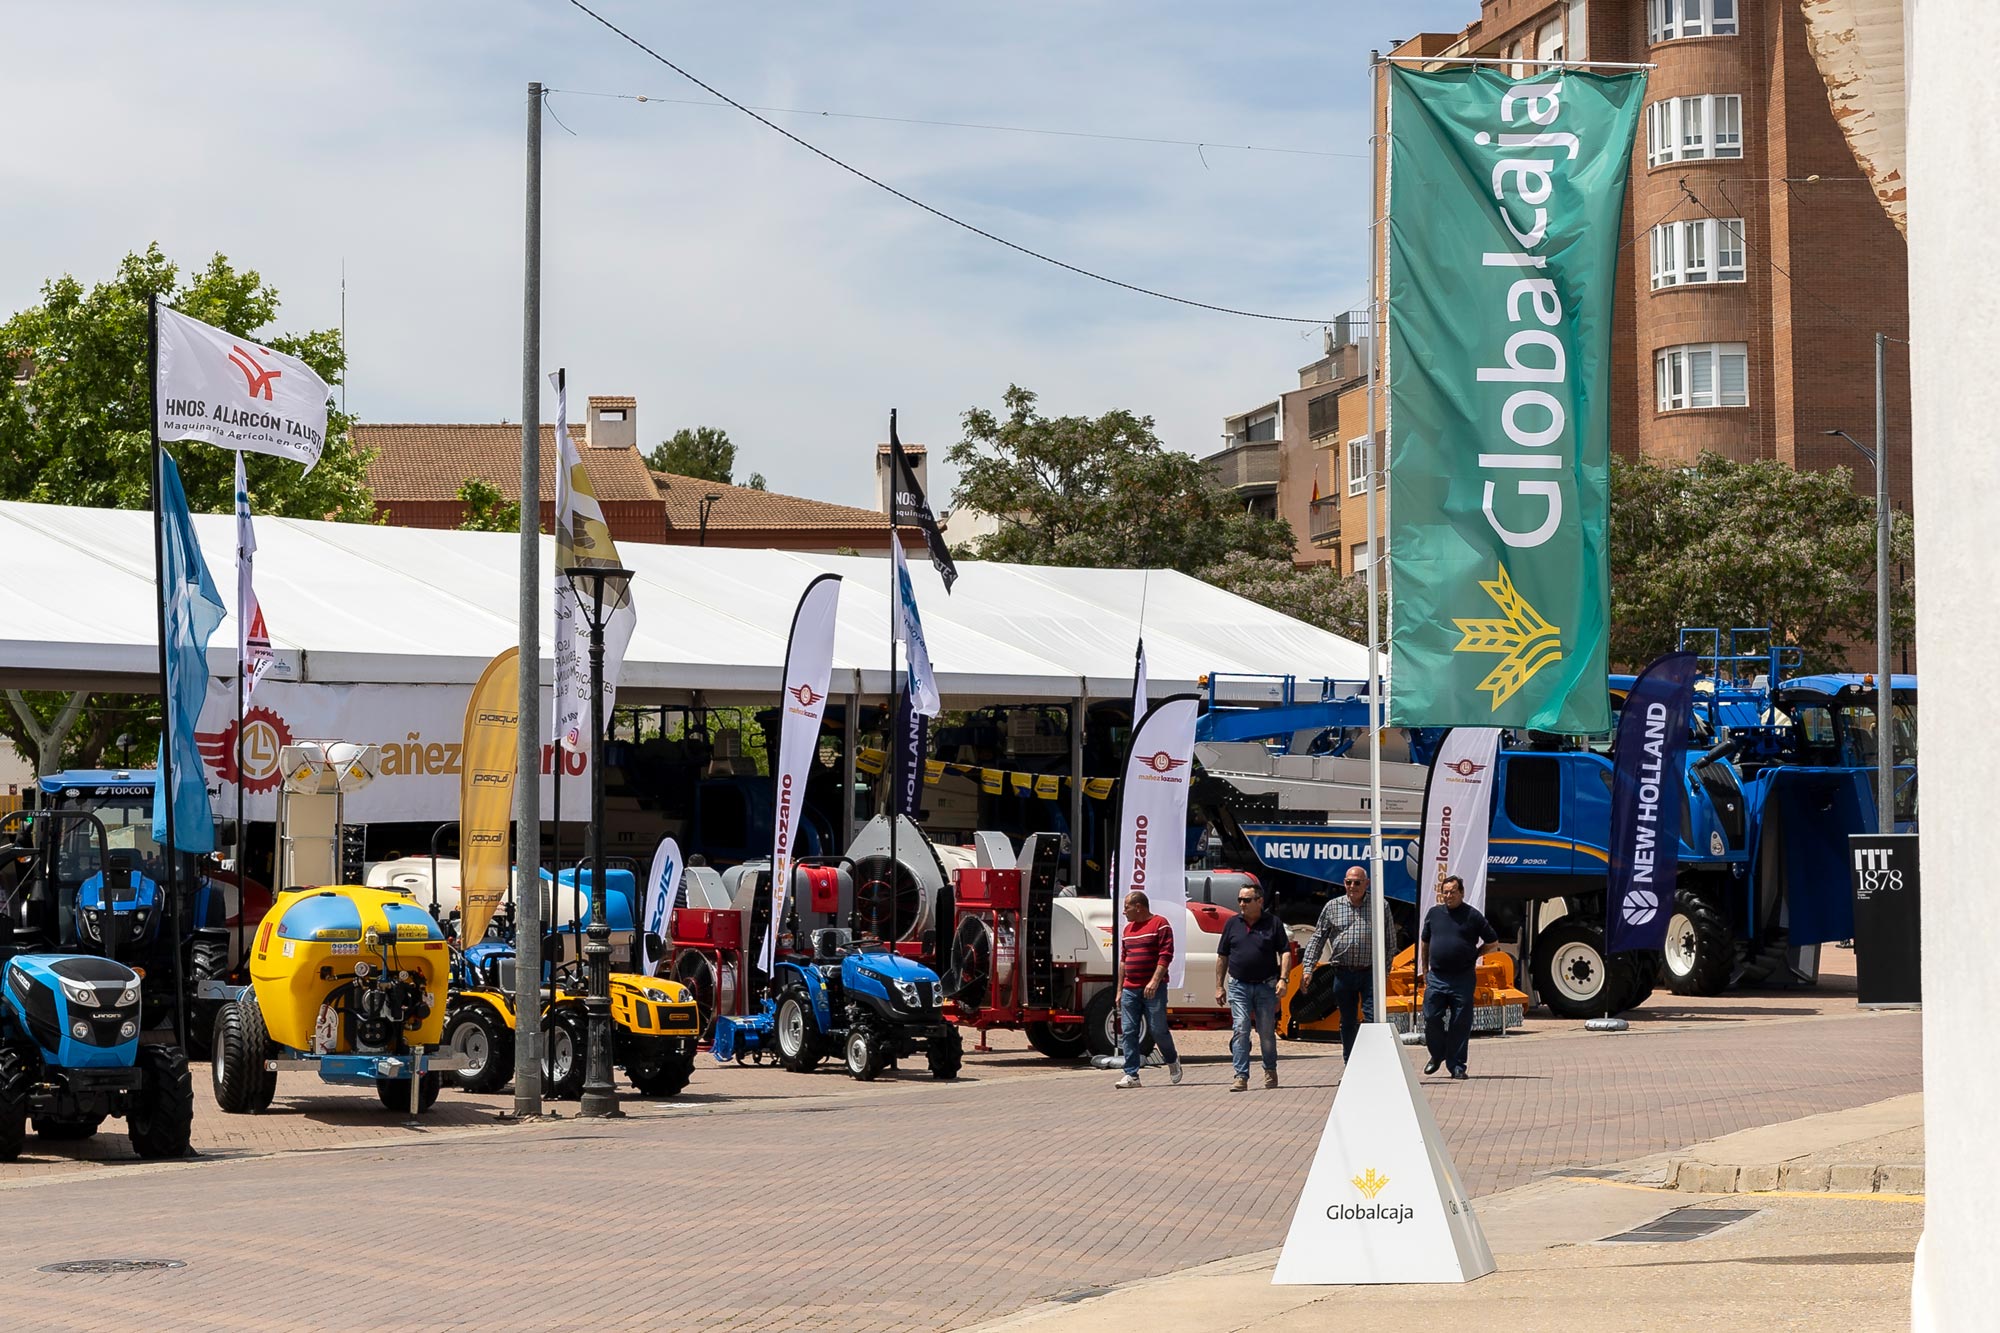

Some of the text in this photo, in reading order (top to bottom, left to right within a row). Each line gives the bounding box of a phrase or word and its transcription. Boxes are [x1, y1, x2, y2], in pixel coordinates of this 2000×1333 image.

[1474, 83, 1579, 549] Globalcaja
[166, 399, 208, 418] HNOS.
[212, 405, 281, 431] ALARCÓN
[163, 421, 290, 447] Maquinaria Agrícola en
[896, 491, 919, 508] NOS.
[354, 732, 461, 775] añez
[111, 787, 149, 795] TOPCON
[1633, 703, 1667, 882] NEW HOLLAND
[777, 774, 792, 854] lozano
[1436, 806, 1452, 861] lozano
[1131, 815, 1148, 891] lozano
[1265, 842, 1310, 859] NEW
[1487, 856, 1518, 864] BRAUD
[1856, 869, 1903, 891] 1878
[1326, 1204, 1414, 1224] Globalcaja
